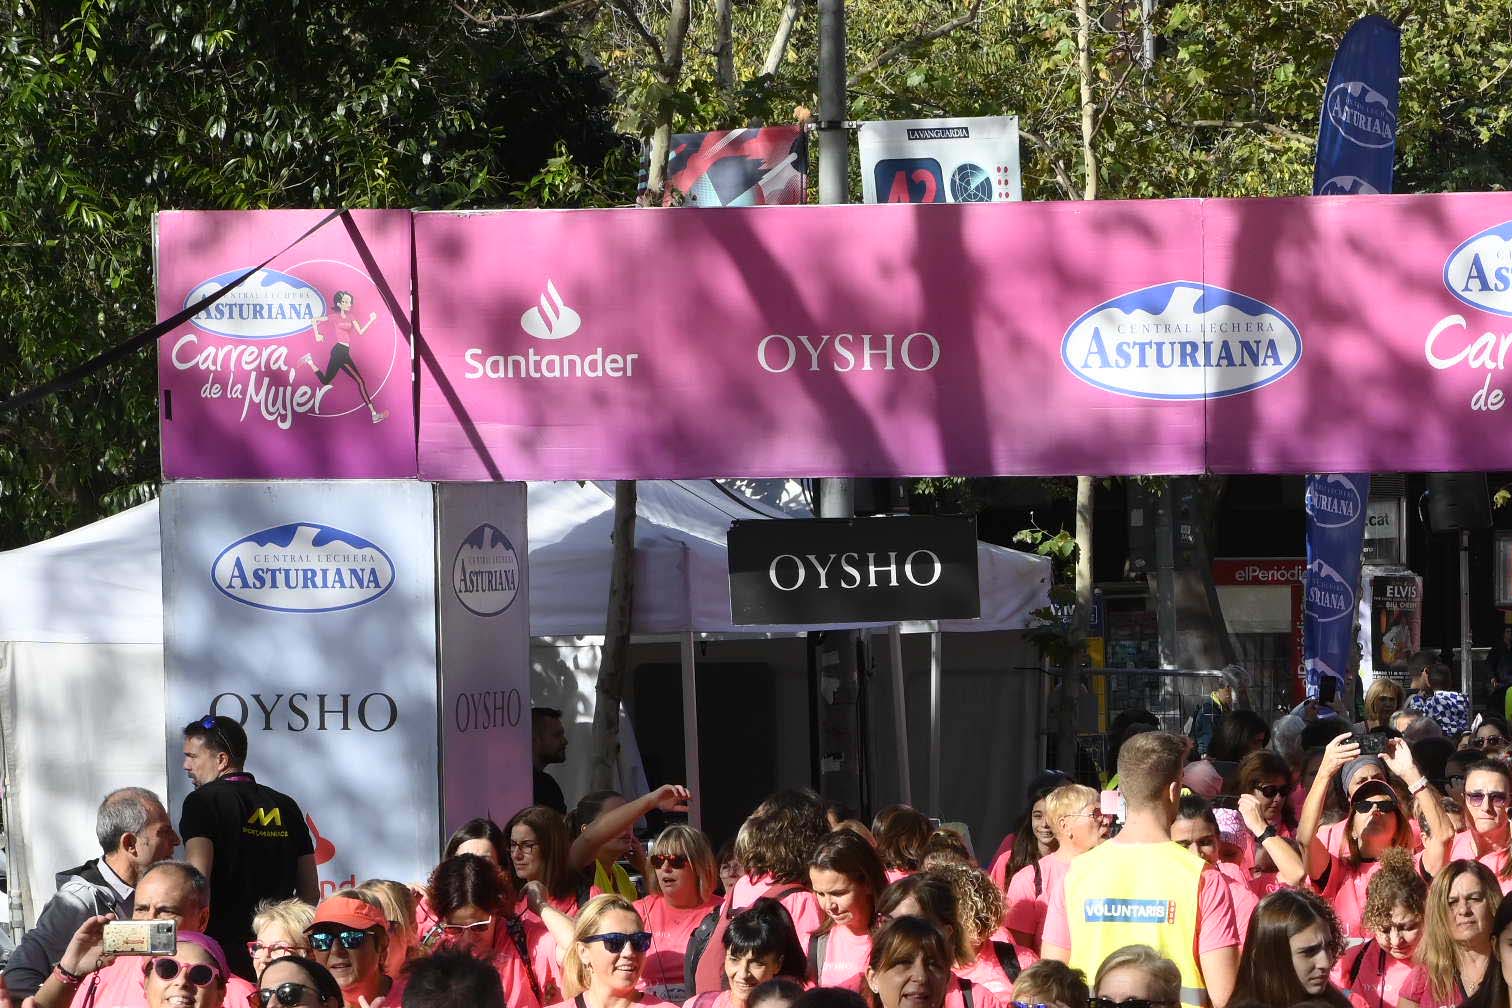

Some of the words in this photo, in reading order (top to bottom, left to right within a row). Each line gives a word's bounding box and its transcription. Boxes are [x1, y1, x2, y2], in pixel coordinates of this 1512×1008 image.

[1117, 323, 1192, 335] CENTRAL
[1200, 322, 1274, 334] LECHERA
[171, 334, 288, 372] Carrera
[464, 347, 639, 380] Santander
[757, 332, 941, 374] OYSHO
[1081, 326, 1284, 370] ASTURIANA
[200, 372, 221, 399] de
[227, 370, 242, 399] la
[241, 367, 333, 430] Mujer
[1471, 373, 1505, 412] de
[226, 556, 382, 590] ASTURIANA
[253, 554, 311, 564] CENTRAL
[318, 553, 376, 563] LECHERA
[458, 558, 517, 594] ASTURIANA
[768, 549, 942, 592] OYSHO
[1387, 585, 1417, 599] ELVIS
[209, 692, 399, 732] OYSHO
[455, 688, 522, 733] OYSHO
[1086, 903, 1165, 918] VOLUNTARIS
